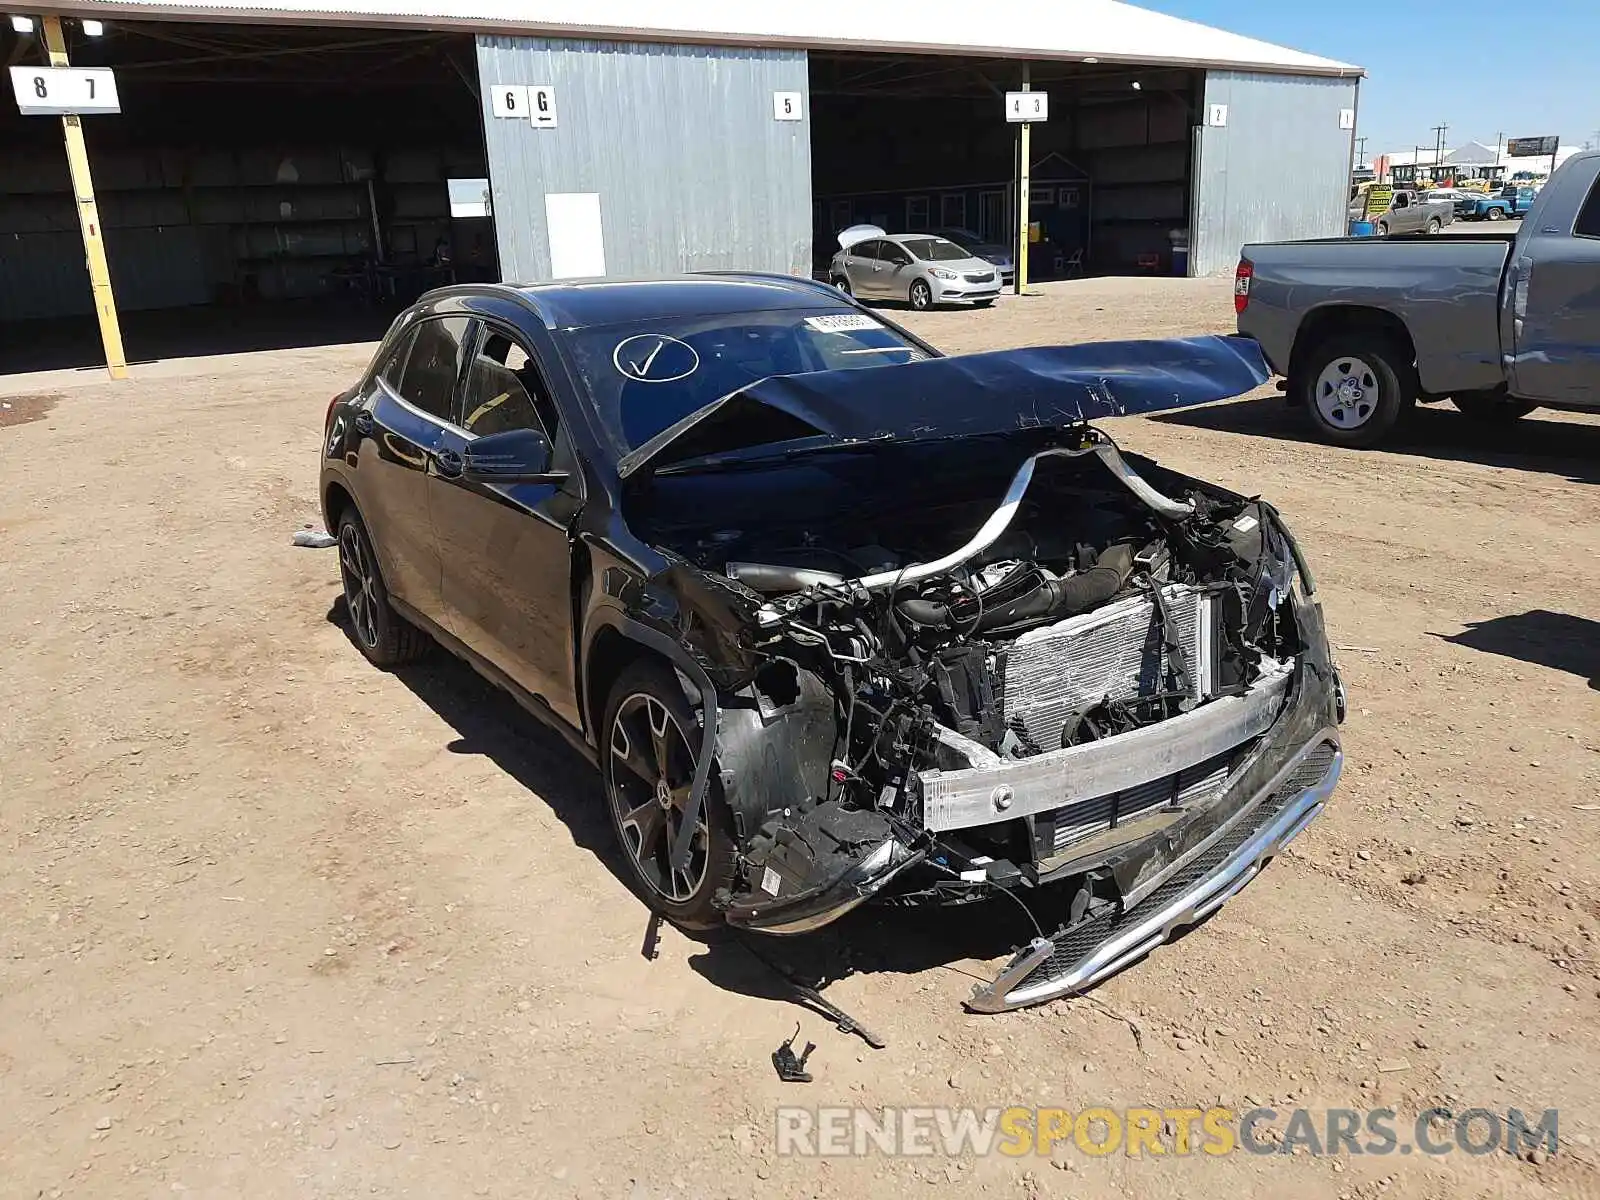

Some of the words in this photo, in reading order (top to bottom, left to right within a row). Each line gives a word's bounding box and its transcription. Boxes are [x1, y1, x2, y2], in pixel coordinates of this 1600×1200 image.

[33, 76, 48, 99] 8
[84, 78, 95, 100] 7
[505, 91, 515, 111] 6
[537, 90, 548, 112] G
[784, 97, 792, 114] 5
[1014, 99, 1020, 114] 4
[1034, 98, 1040, 113] 3
[1216, 108, 1221, 122] 2
